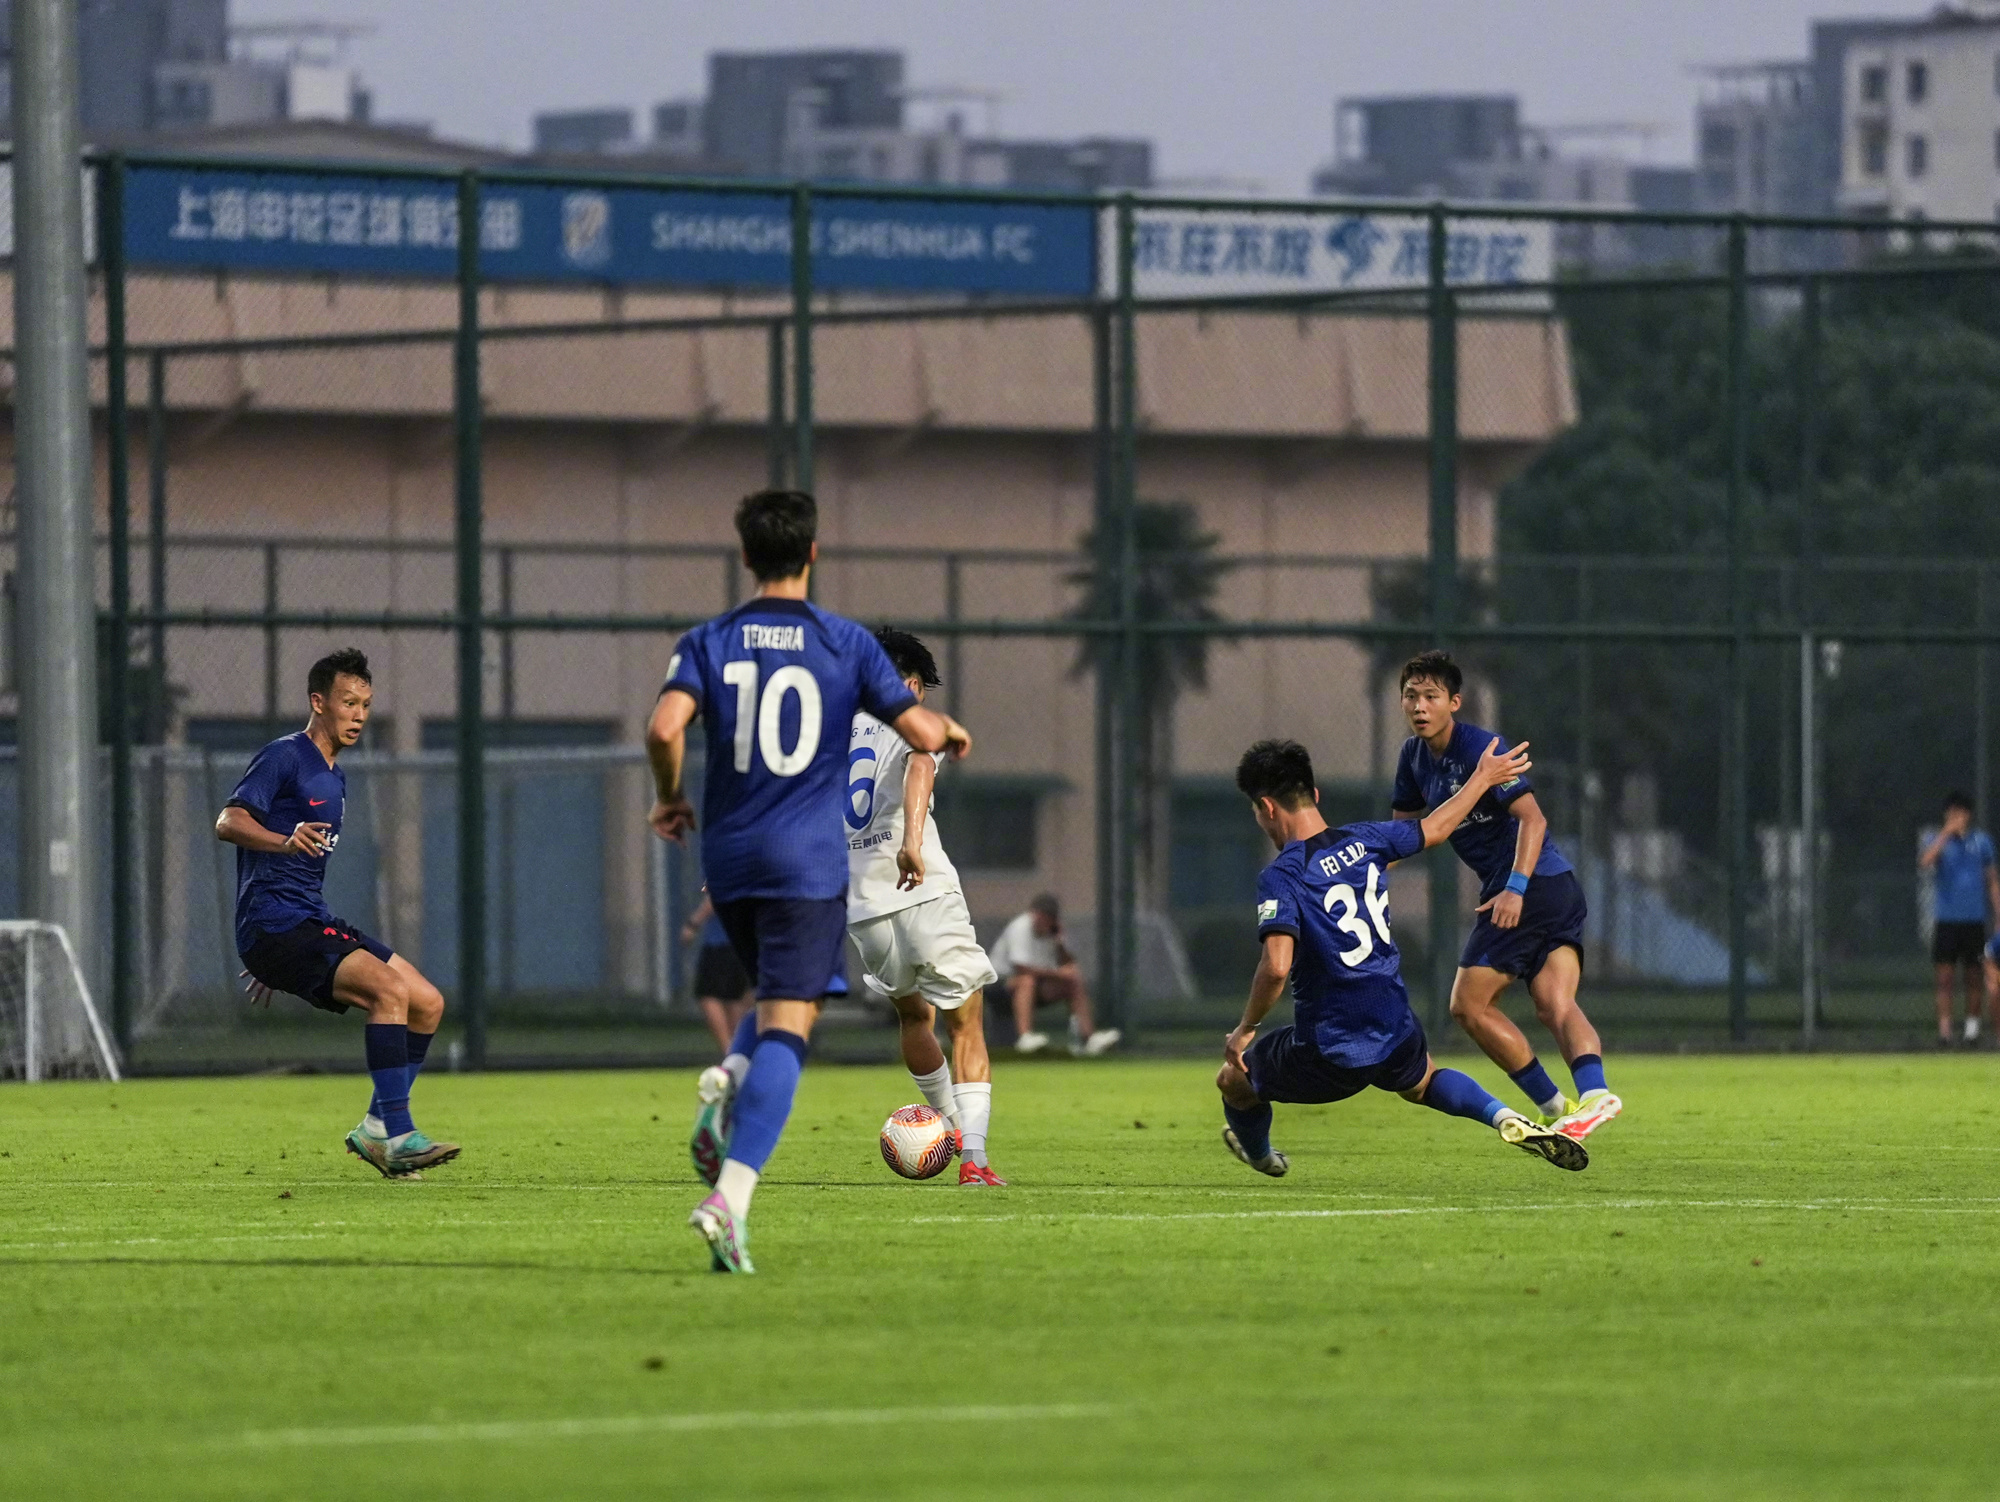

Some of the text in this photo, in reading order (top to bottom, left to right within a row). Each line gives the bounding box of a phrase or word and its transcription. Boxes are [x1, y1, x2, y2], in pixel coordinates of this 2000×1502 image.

[829, 218, 984, 260] SHENHUA
[993, 223, 1034, 264] FC
[742, 624, 804, 651] TEIXEIRA
[723, 661, 822, 777] 10
[1319, 856, 1341, 877] FEI
[1324, 862, 1390, 967] 36
